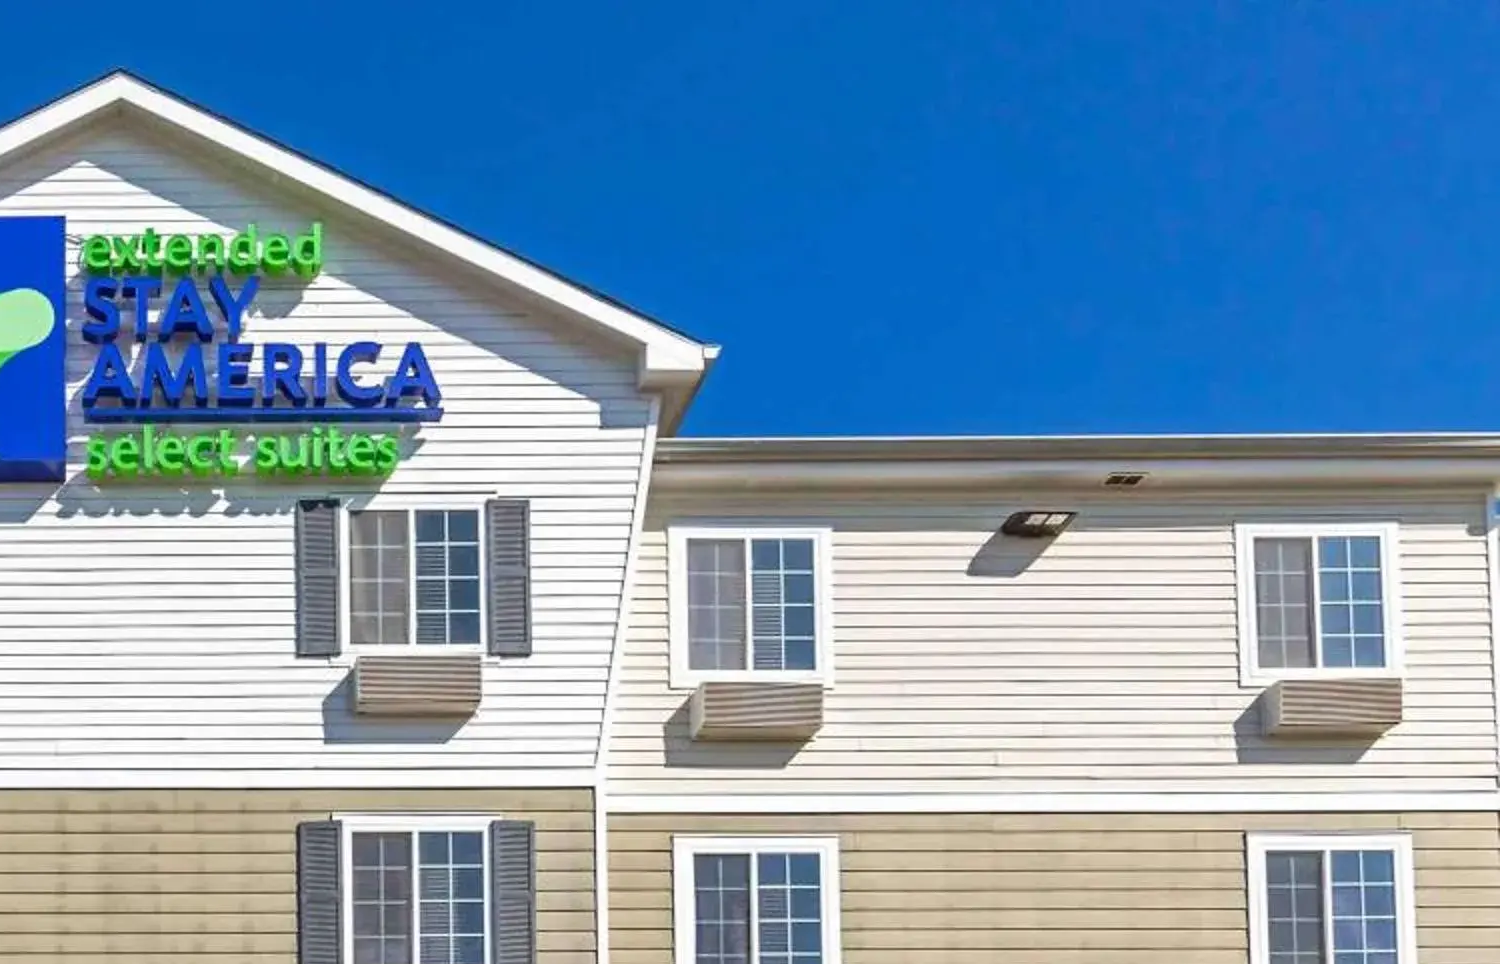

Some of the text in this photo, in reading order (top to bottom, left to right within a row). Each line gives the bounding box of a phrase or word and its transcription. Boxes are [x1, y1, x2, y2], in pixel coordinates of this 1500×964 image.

[83, 223, 324, 275] extended
[82, 276, 260, 344] STAY
[82, 341, 442, 408] AMERICA
[84, 424, 400, 477] select suites
